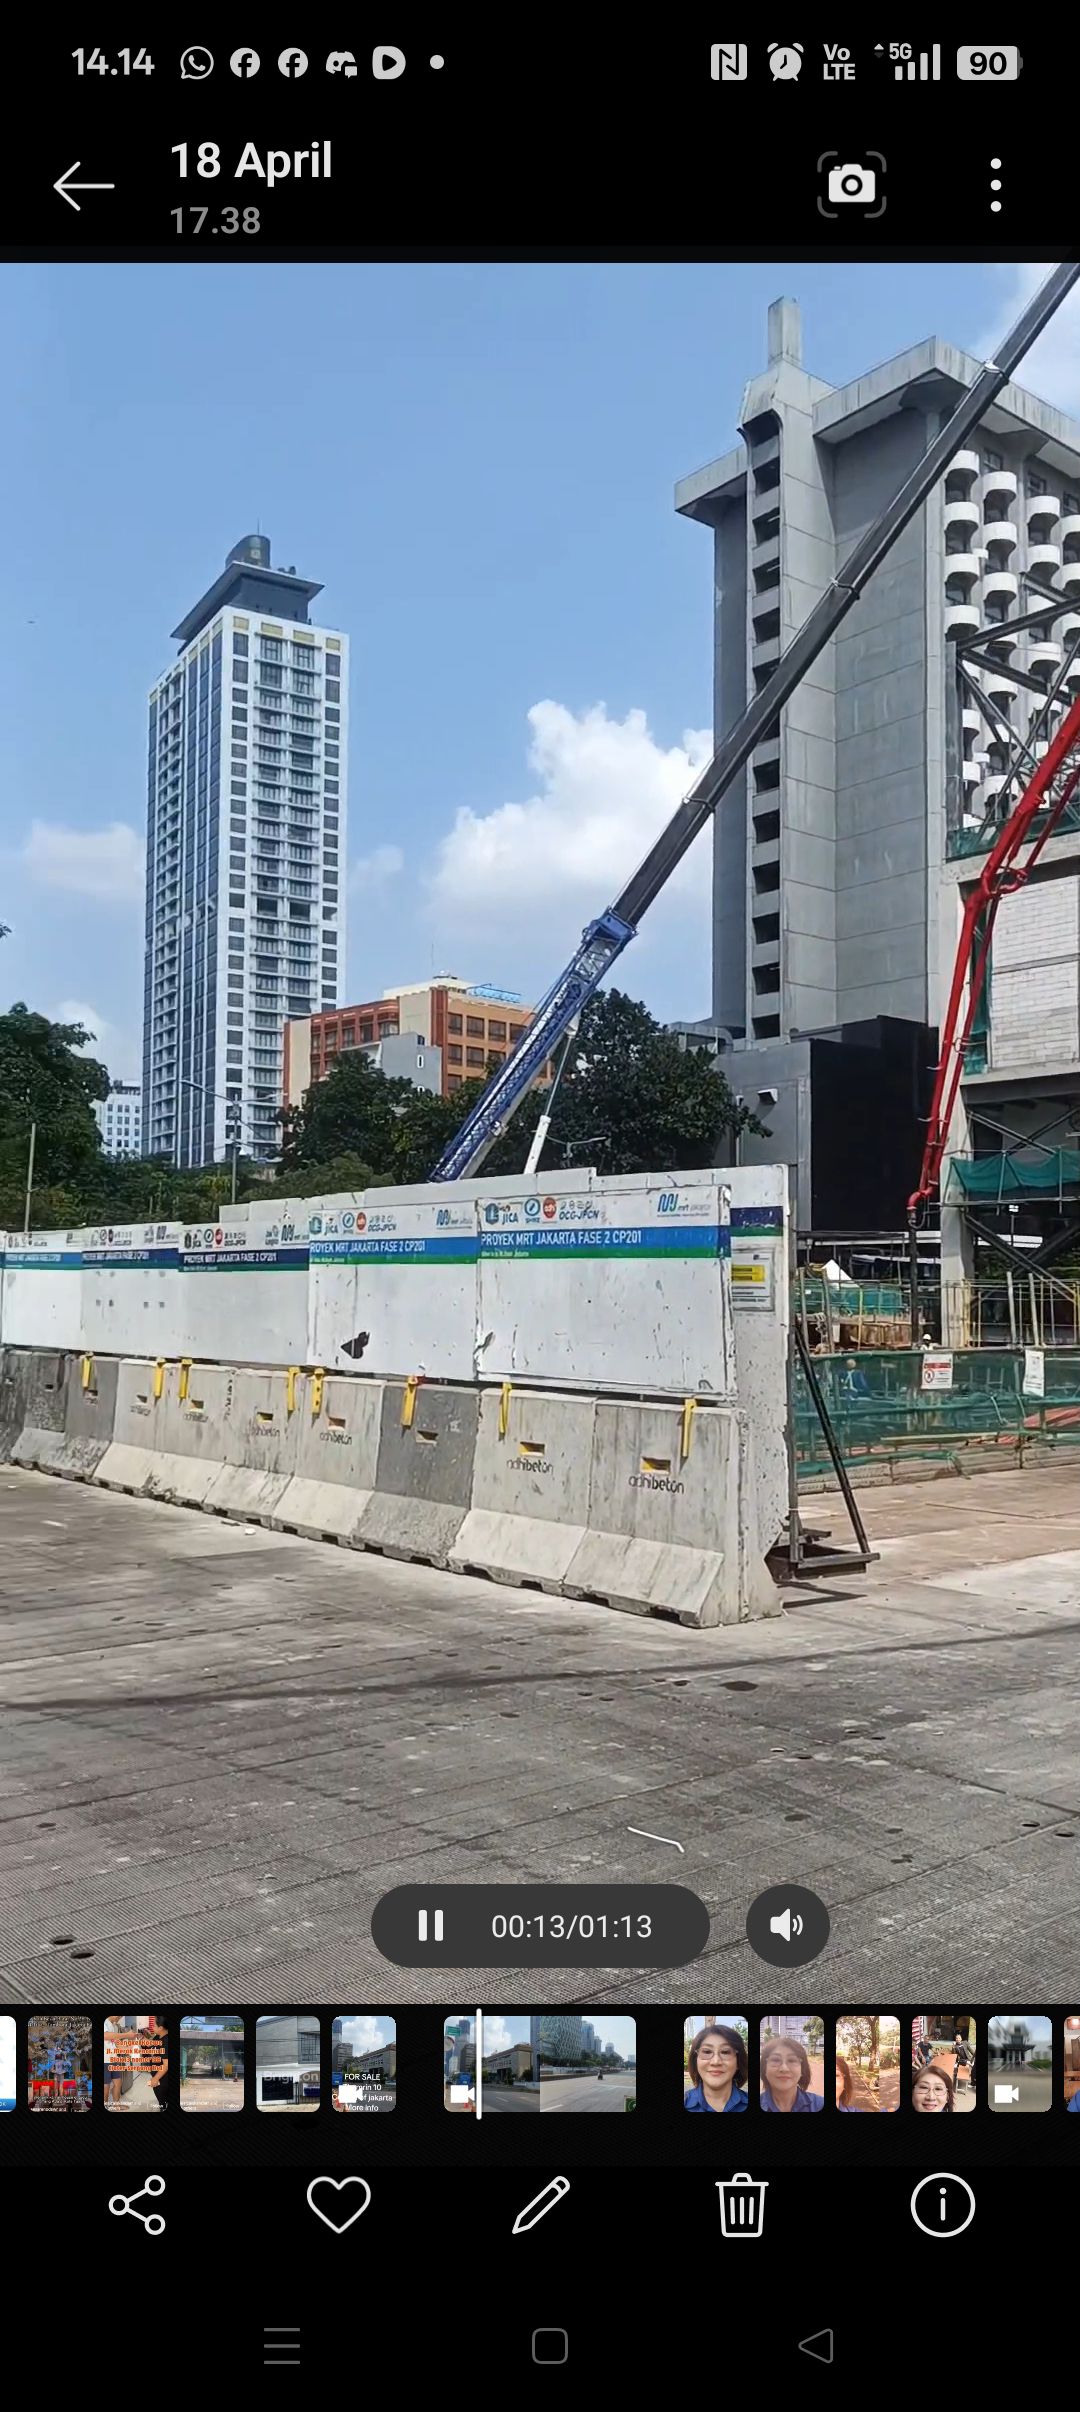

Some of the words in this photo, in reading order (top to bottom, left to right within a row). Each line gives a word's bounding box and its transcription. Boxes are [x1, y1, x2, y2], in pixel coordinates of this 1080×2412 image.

[502, 1212, 518, 1225] JICA
[481, 1233, 514, 1246] PROYEK
[515, 1232, 534, 1246] MRT
[536, 1232, 576, 1245] JAKARTA
[578, 1231, 602, 1244] FASE
[604, 1231, 610, 1244] 2
[612, 1230, 641, 1244] CP201
[310, 1242, 334, 1253] ROYEK
[335, 1242, 349, 1253] MRT
[350, 1241, 380, 1253] JAKARTA
[381, 1241, 398, 1252] FASE
[399, 1241, 404, 1251] 2
[405, 1240, 426, 1252] CP201
[217, 1254, 240, 1263] JAKARTA
[241, 1253, 255, 1262] FASE
[628, 1474, 685, 1495] adhibeton
